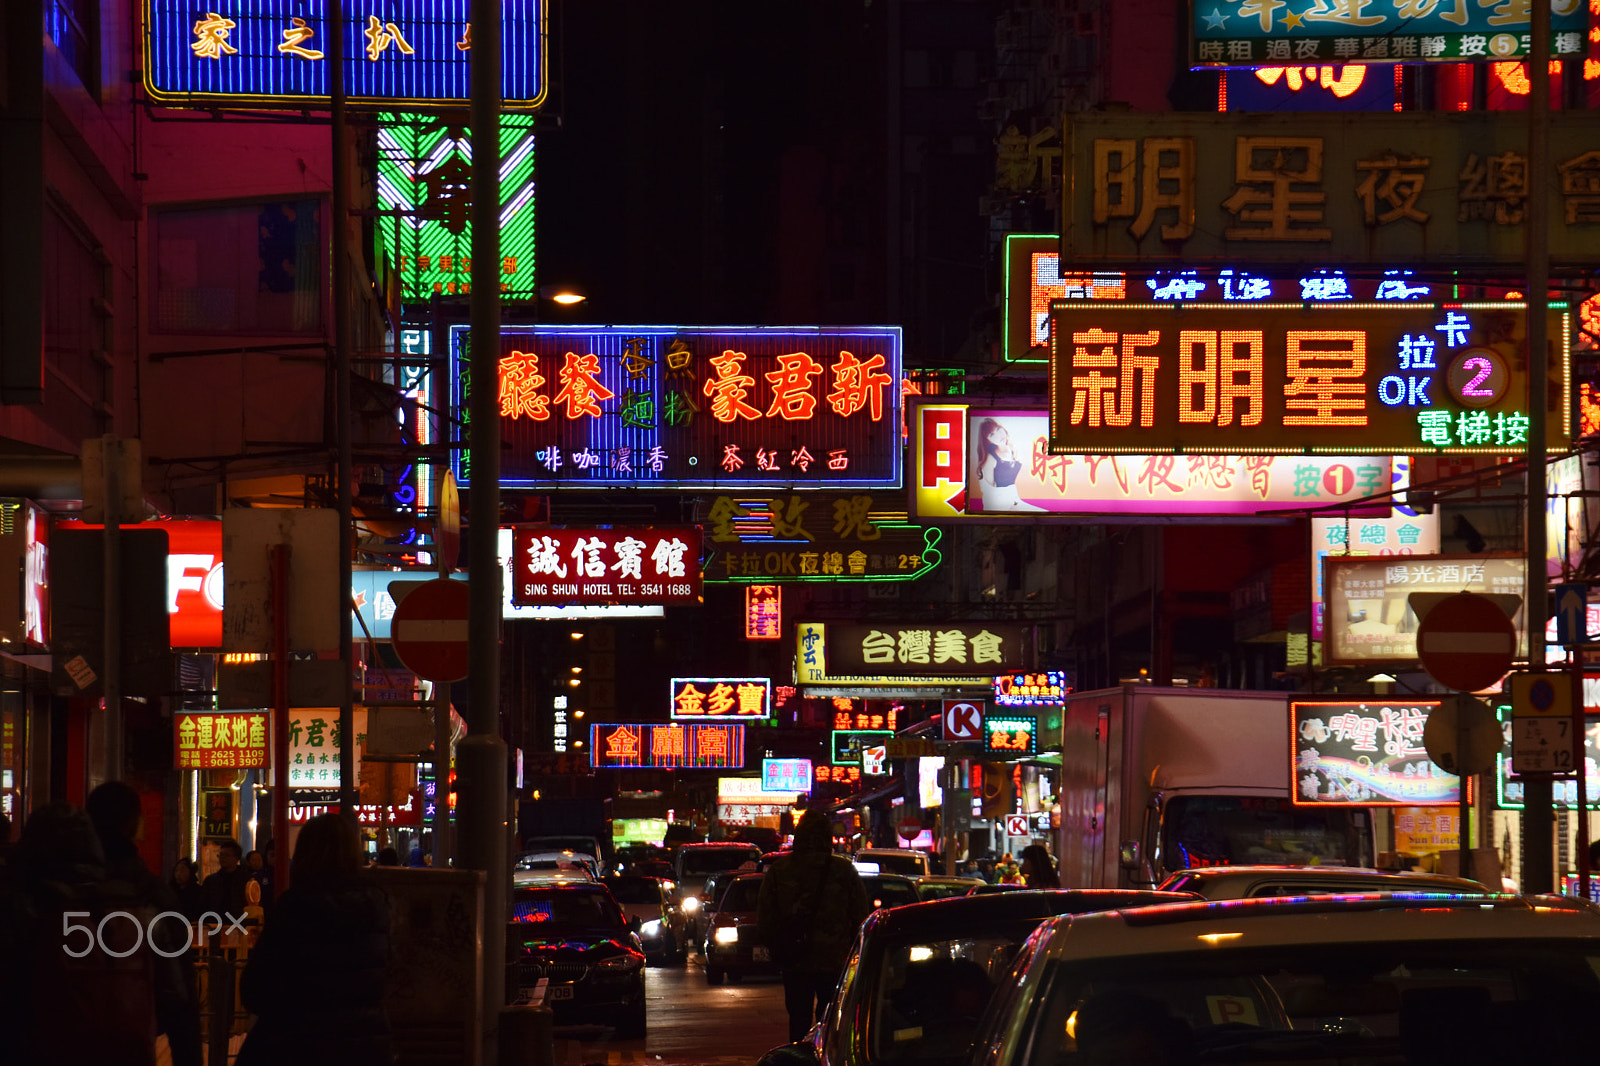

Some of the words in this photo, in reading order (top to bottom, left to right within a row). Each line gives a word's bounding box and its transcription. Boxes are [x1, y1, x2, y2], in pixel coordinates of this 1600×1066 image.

[1198, 40, 1252, 61] 時租
[1267, 38, 1320, 60] 過夜
[1334, 36, 1447, 58] 華麗雅靜
[1070, 327, 1368, 428] 新明星
[1462, 357, 1494, 397] 2
[1417, 410, 1530, 446] 電梯按
[1293, 463, 1383, 497] 按1字
[1325, 523, 1422, 545] 夜總會
[526, 535, 689, 579] 誠信賓館
[719, 550, 868, 575] 卡拉OK夜總會
[1385, 564, 1486, 584] 陽光酒店
[525, 583, 548, 596] SING
[552, 583, 578, 596] SHUN
[583, 583, 613, 596] HOTEL
[617, 583, 636, 596] TEL:
[640, 583, 663, 596] 3541
[667, 583, 691, 596] 1688
[861, 629, 1004, 664] 台灣美食
[674, 682, 766, 715] 金多寶
[179, 714, 265, 749] 金運來地產
[988, 720, 1031, 731] TATTOO
[991, 731, 1030, 750] 紋身
[211, 750, 235, 759] 2625
[239, 750, 264, 758] 1109
[211, 759, 235, 767] 9043
[239, 758, 264, 767] 3907
[1553, 750, 1570, 768] 12
[1409, 835, 1428, 845] Sun
